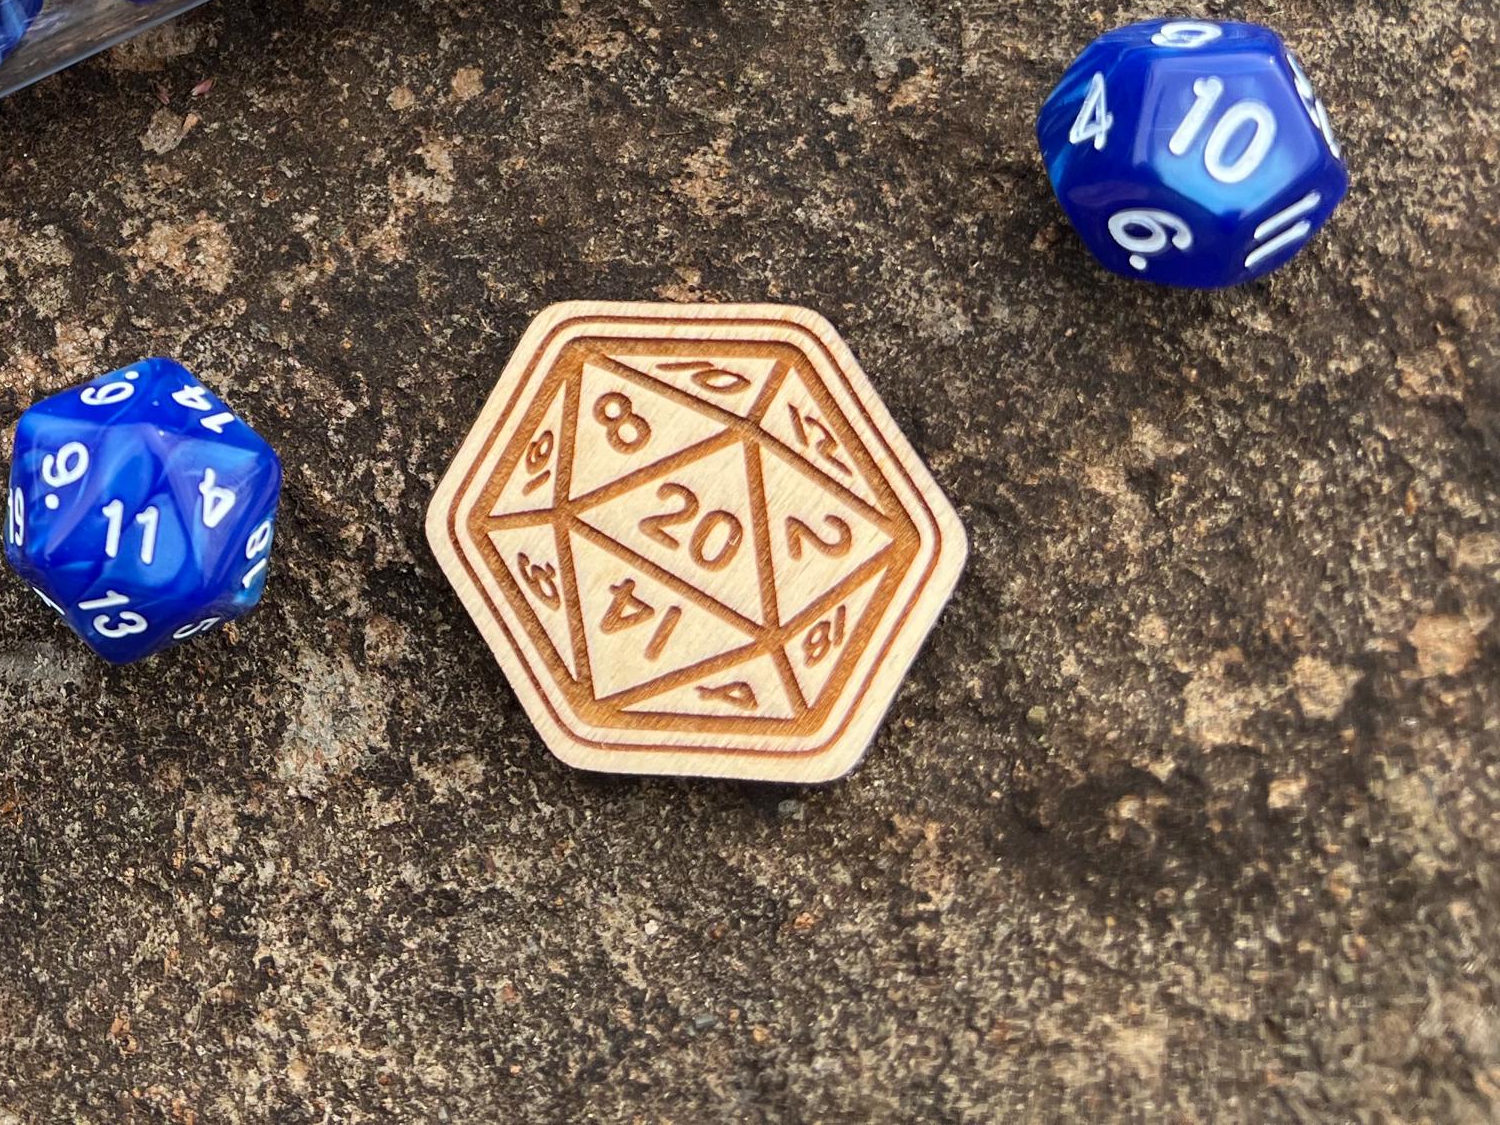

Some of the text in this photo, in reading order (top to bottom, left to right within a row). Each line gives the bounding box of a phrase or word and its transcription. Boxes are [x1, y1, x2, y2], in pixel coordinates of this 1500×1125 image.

[1069, 71, 1114, 151] 4
[1168, 75, 1277, 184] 10
[655, 360, 751, 393] 10
[172, 384, 235, 434] 14
[593, 391, 652, 455] 8
[789, 403, 854, 477] 12
[198, 467, 236, 529] 4
[638, 482, 743, 573] 20
[102, 499, 159, 565] 11
[784, 514, 853, 561] 2
[78, 590, 149, 638] 13
[599, 579, 682, 660] 14
[803, 605, 845, 668] 18
[695, 681, 759, 709] 4
